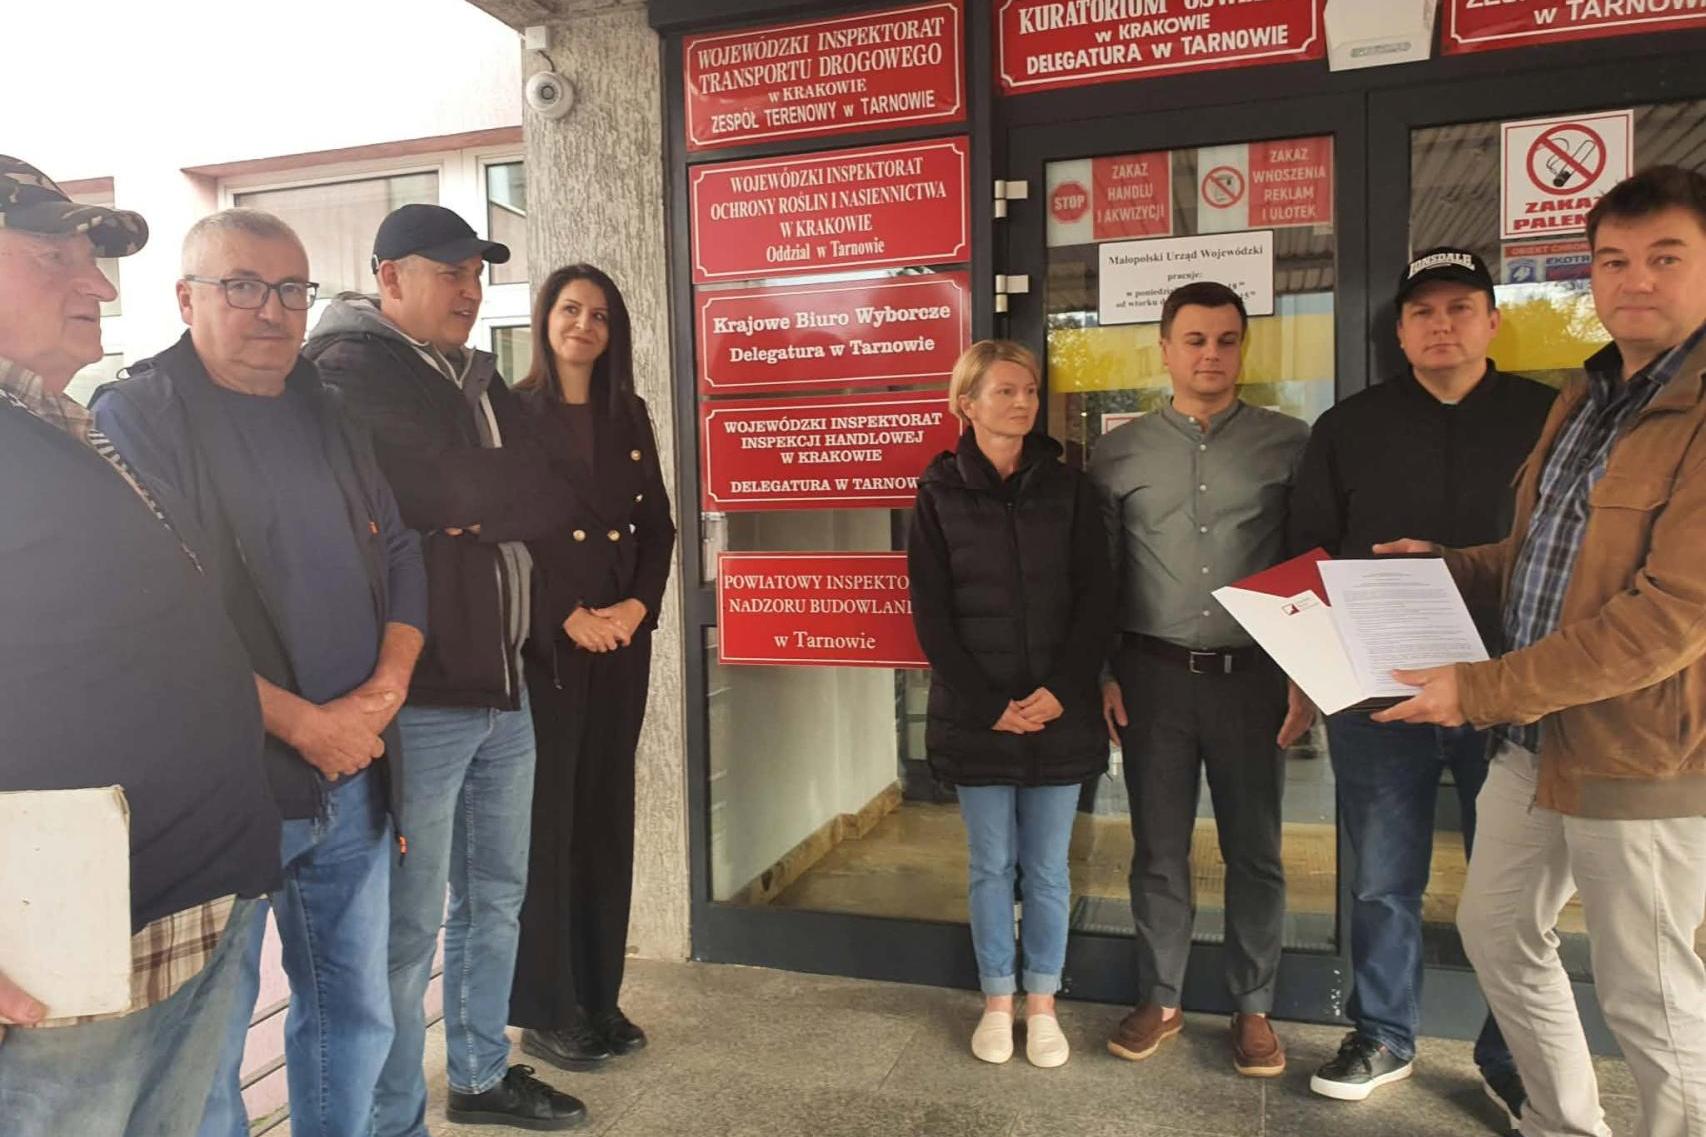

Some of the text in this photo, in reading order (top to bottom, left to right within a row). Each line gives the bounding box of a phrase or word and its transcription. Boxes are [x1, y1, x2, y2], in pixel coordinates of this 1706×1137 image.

[1534, 7, 1557, 25] w
[1095, 13, 1210, 43] w KRAKOWIE
[698, 16, 944, 69] WOJEWÓDZKI INSPEKTORAT
[1027, 24, 1288, 75] DELEGATURA w TARNOWIE
[699, 42, 942, 95] TRANSPORTU DROGOWEGO
[783, 78, 867, 102] KRAKOWIE
[711, 107, 759, 133] ZESPÓŁ
[764, 102, 837, 127] TERENOWY
[860, 90, 935, 116] TARNOWIE
[1270, 148, 1308, 163] ZAKAZ
[730, 157, 924, 193] WOJEWÓDZKI INSPEKTORAT
[1112, 163, 1148, 179] ZAKAZ
[1252, 164, 1327, 183] WNOSZENIA
[711, 180, 946, 220] OCHRONY ROŚLIN I NASIENNICTWA
[1107, 183, 1153, 200] HANDLU
[1264, 185, 1314, 201] REKLAM
[1053, 195, 1085, 210] STOP
[1525, 197, 1599, 213] ZAKA
[1269, 204, 1317, 220] ULOTEK
[780, 214, 872, 238] W KRAKOWIE
[1514, 214, 1587, 230] PALEN
[817, 247, 827, 257] w
[830, 237, 885, 257] Tarnowie
[1167, 251, 1197, 261] Urząd
[1200, 245, 1263, 259] Wojewódzki
[713, 304, 950, 336] Krajowe Biuro Wyborcze
[730, 335, 935, 364] Delegatura w Tarnowie
[724, 412, 943, 433] WOJEWÓDZKI INSPEKTORAT
[741, 430, 924, 449] INSPEKCJI HANDLOWEJ
[780, 449, 883, 464] W KRAKOWIE
[730, 476, 920, 493] DELEGATURA W TARNOW
[724, 574, 910, 590] POWIATOWY INSPEKTO
[729, 598, 913, 614] NADZORU BUDOWLAN
[774, 631, 876, 649] w Tarnowie
